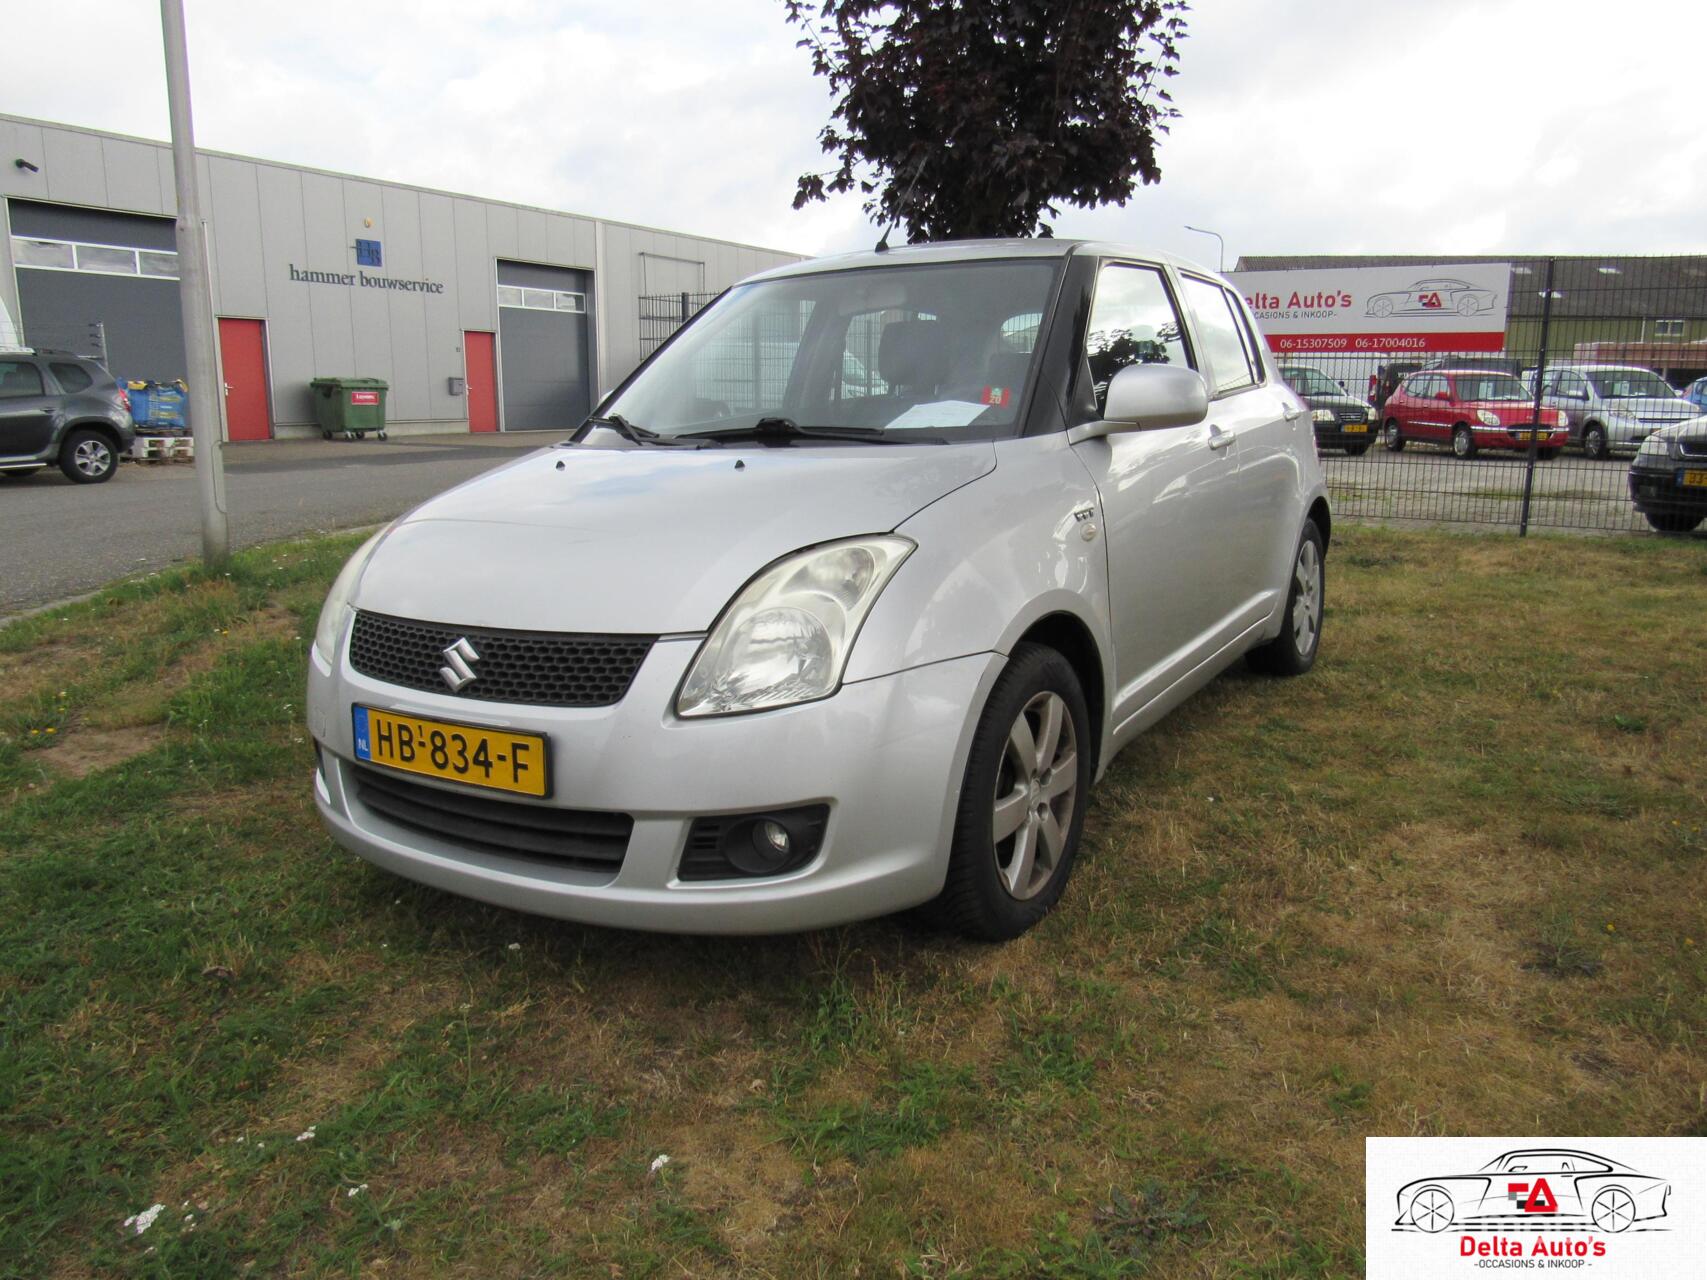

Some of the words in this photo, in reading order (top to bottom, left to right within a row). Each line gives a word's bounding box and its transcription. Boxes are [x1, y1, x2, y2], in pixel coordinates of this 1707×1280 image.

[289, 264, 356, 286] hammer
[360, 271, 444, 294] bouwservice
[1246, 292, 1280, 309] elta
[1287, 290, 1352, 309] Auto's
[1280, 339, 1347, 349] 06-15307509
[1355, 338, 1425, 348] 06-17004016
[358, 737, 369, 752] NL
